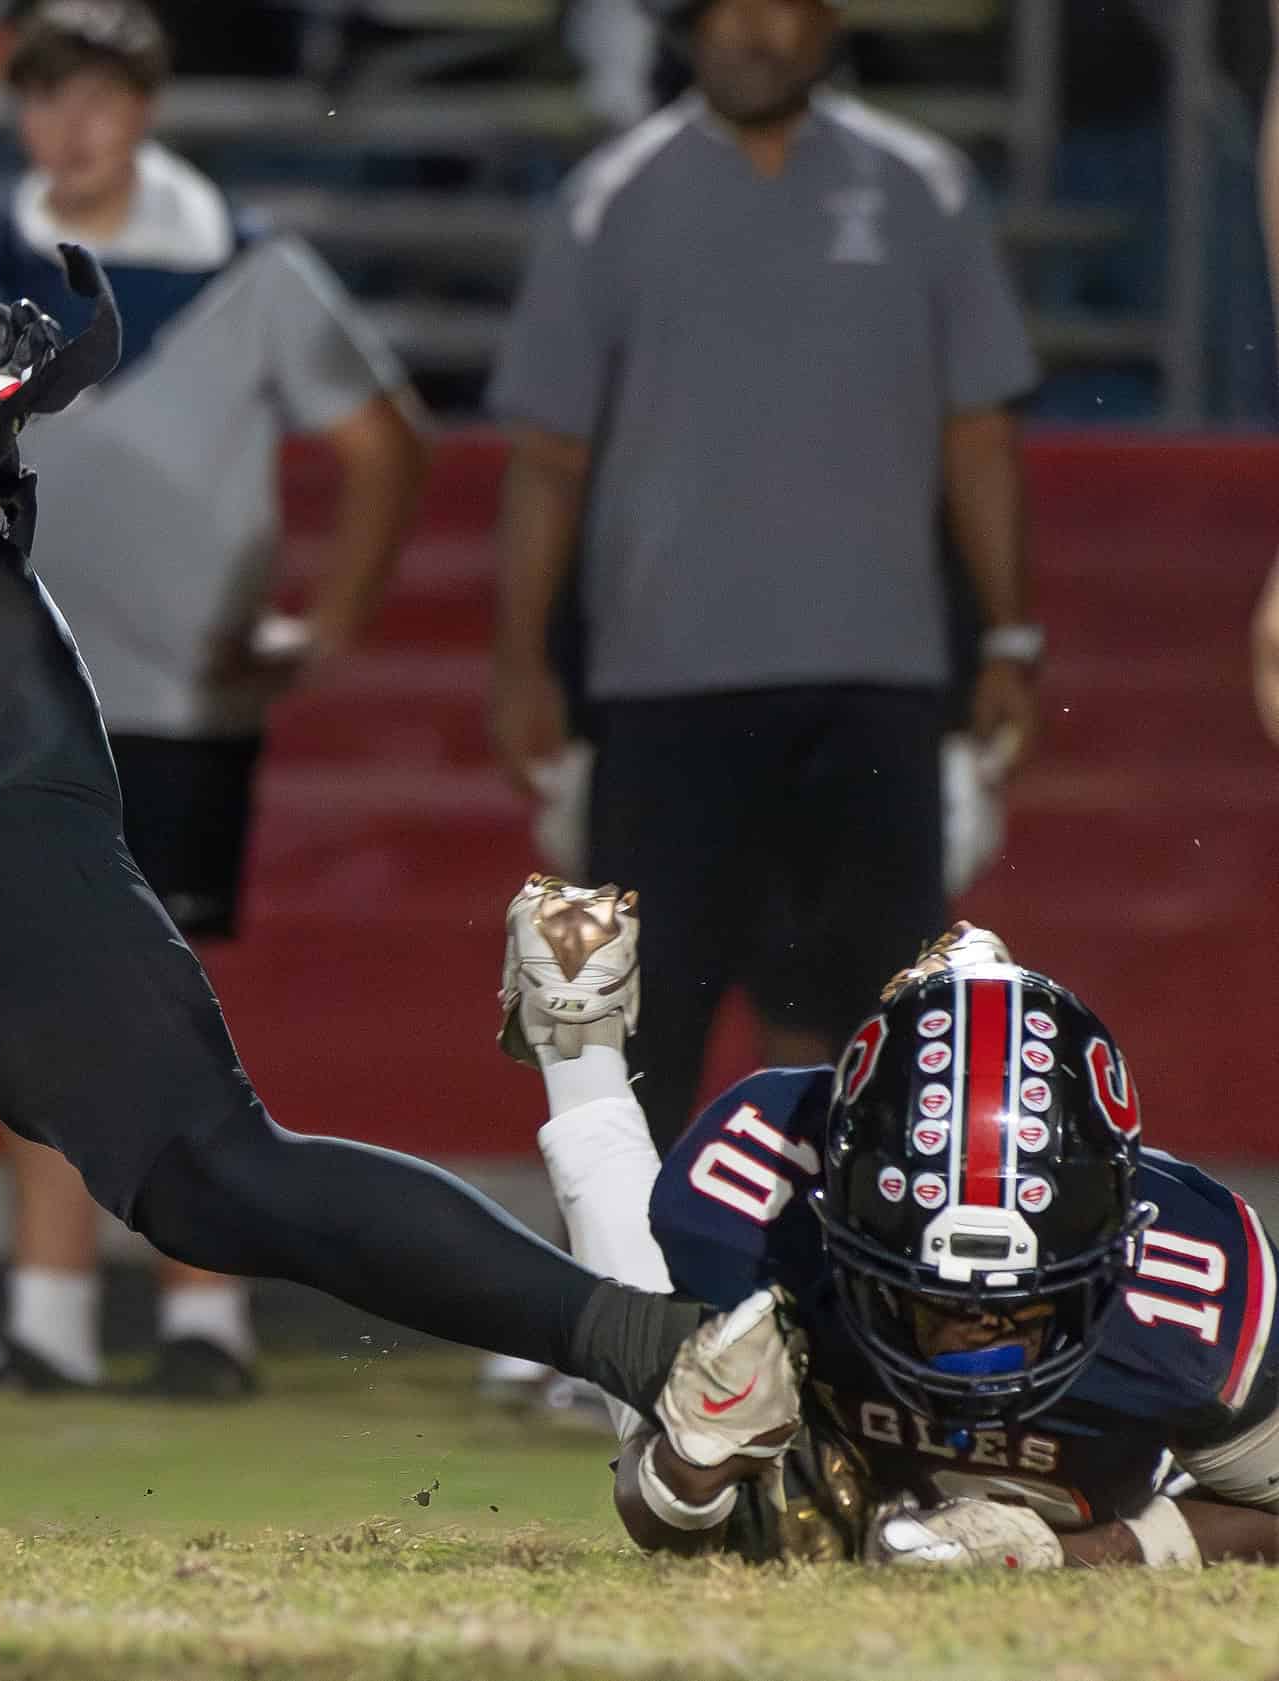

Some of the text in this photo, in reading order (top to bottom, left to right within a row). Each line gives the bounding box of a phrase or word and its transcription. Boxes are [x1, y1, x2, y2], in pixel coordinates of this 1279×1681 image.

[689, 1101, 820, 1226] 10
[1125, 1228, 1228, 1346] 10
[860, 1400, 1059, 1473] GLES
